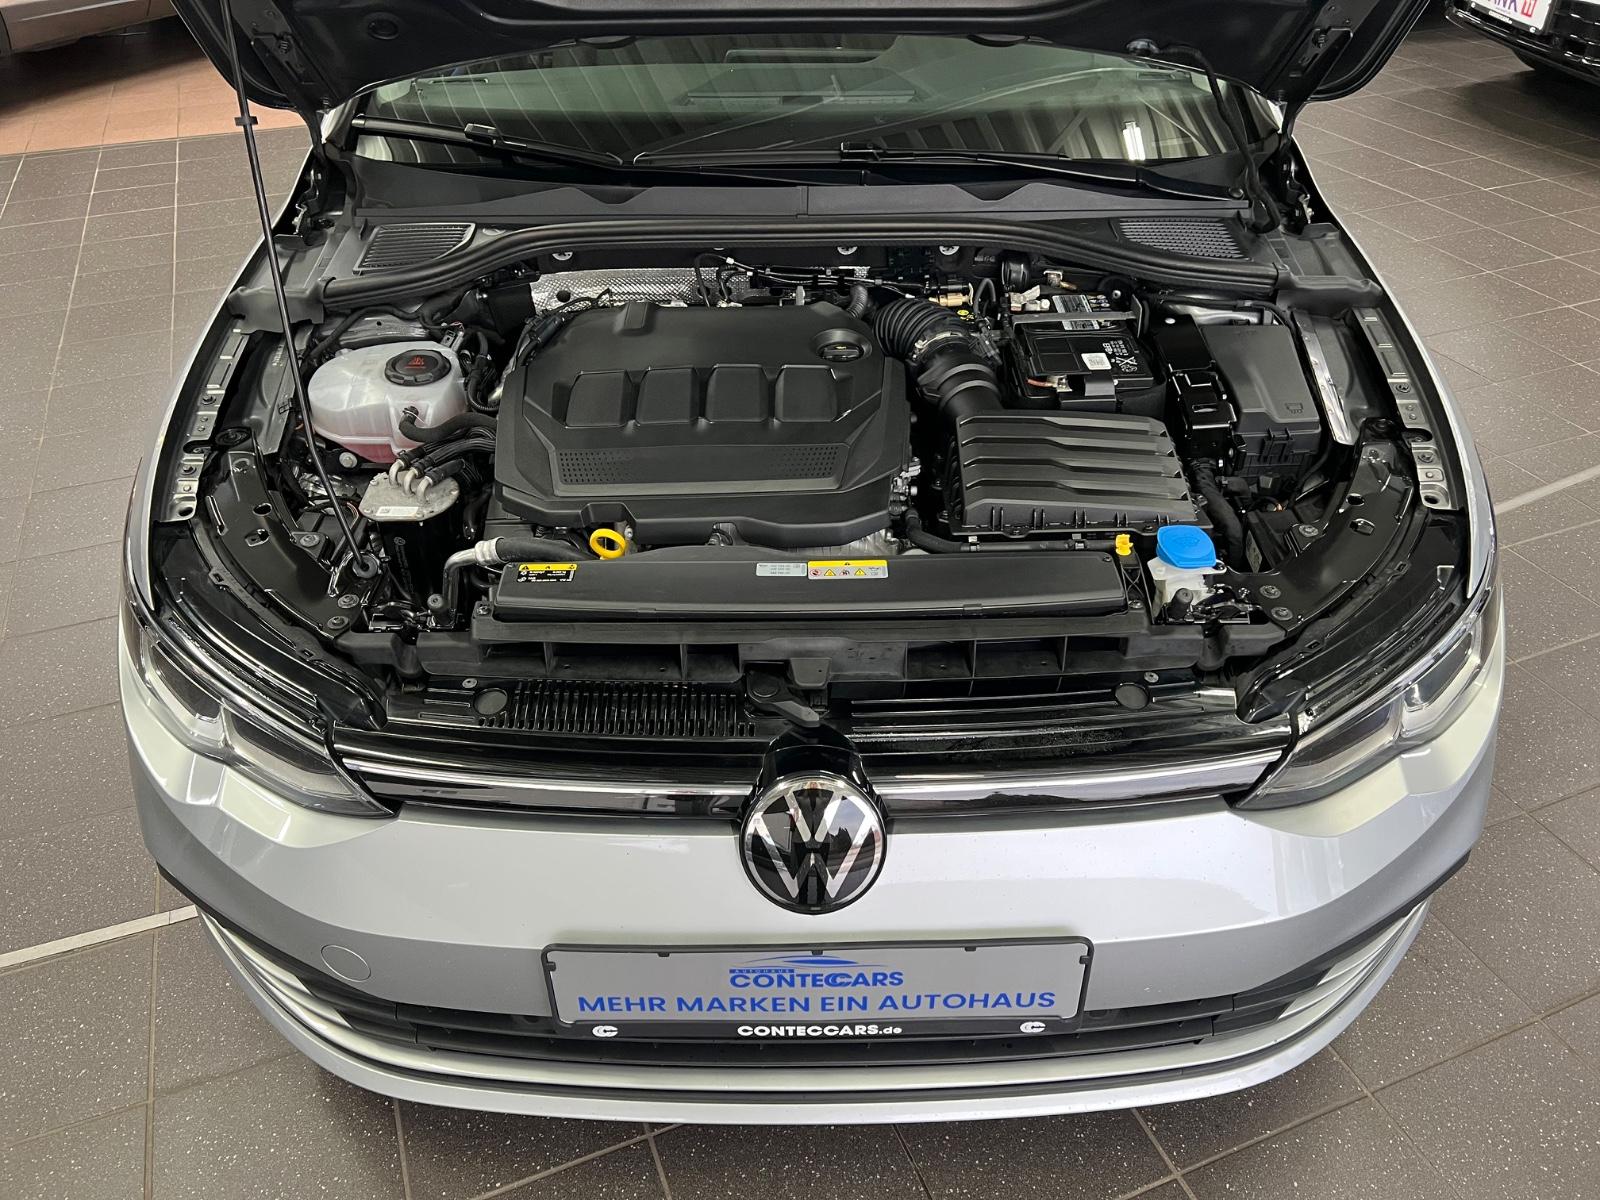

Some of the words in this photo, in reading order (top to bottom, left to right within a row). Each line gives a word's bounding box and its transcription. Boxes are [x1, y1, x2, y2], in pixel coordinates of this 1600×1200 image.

[743, 778, 884, 909] VW
[730, 972, 904, 988] CONTECCARS
[578, 996, 666, 1012] MEHR
[677, 996, 810, 1013] MARKEN
[820, 996, 868, 1012] EIN
[878, 992, 1056, 1011] AUTOHAUS
[737, 1025, 903, 1037] CONTECCARS.de
